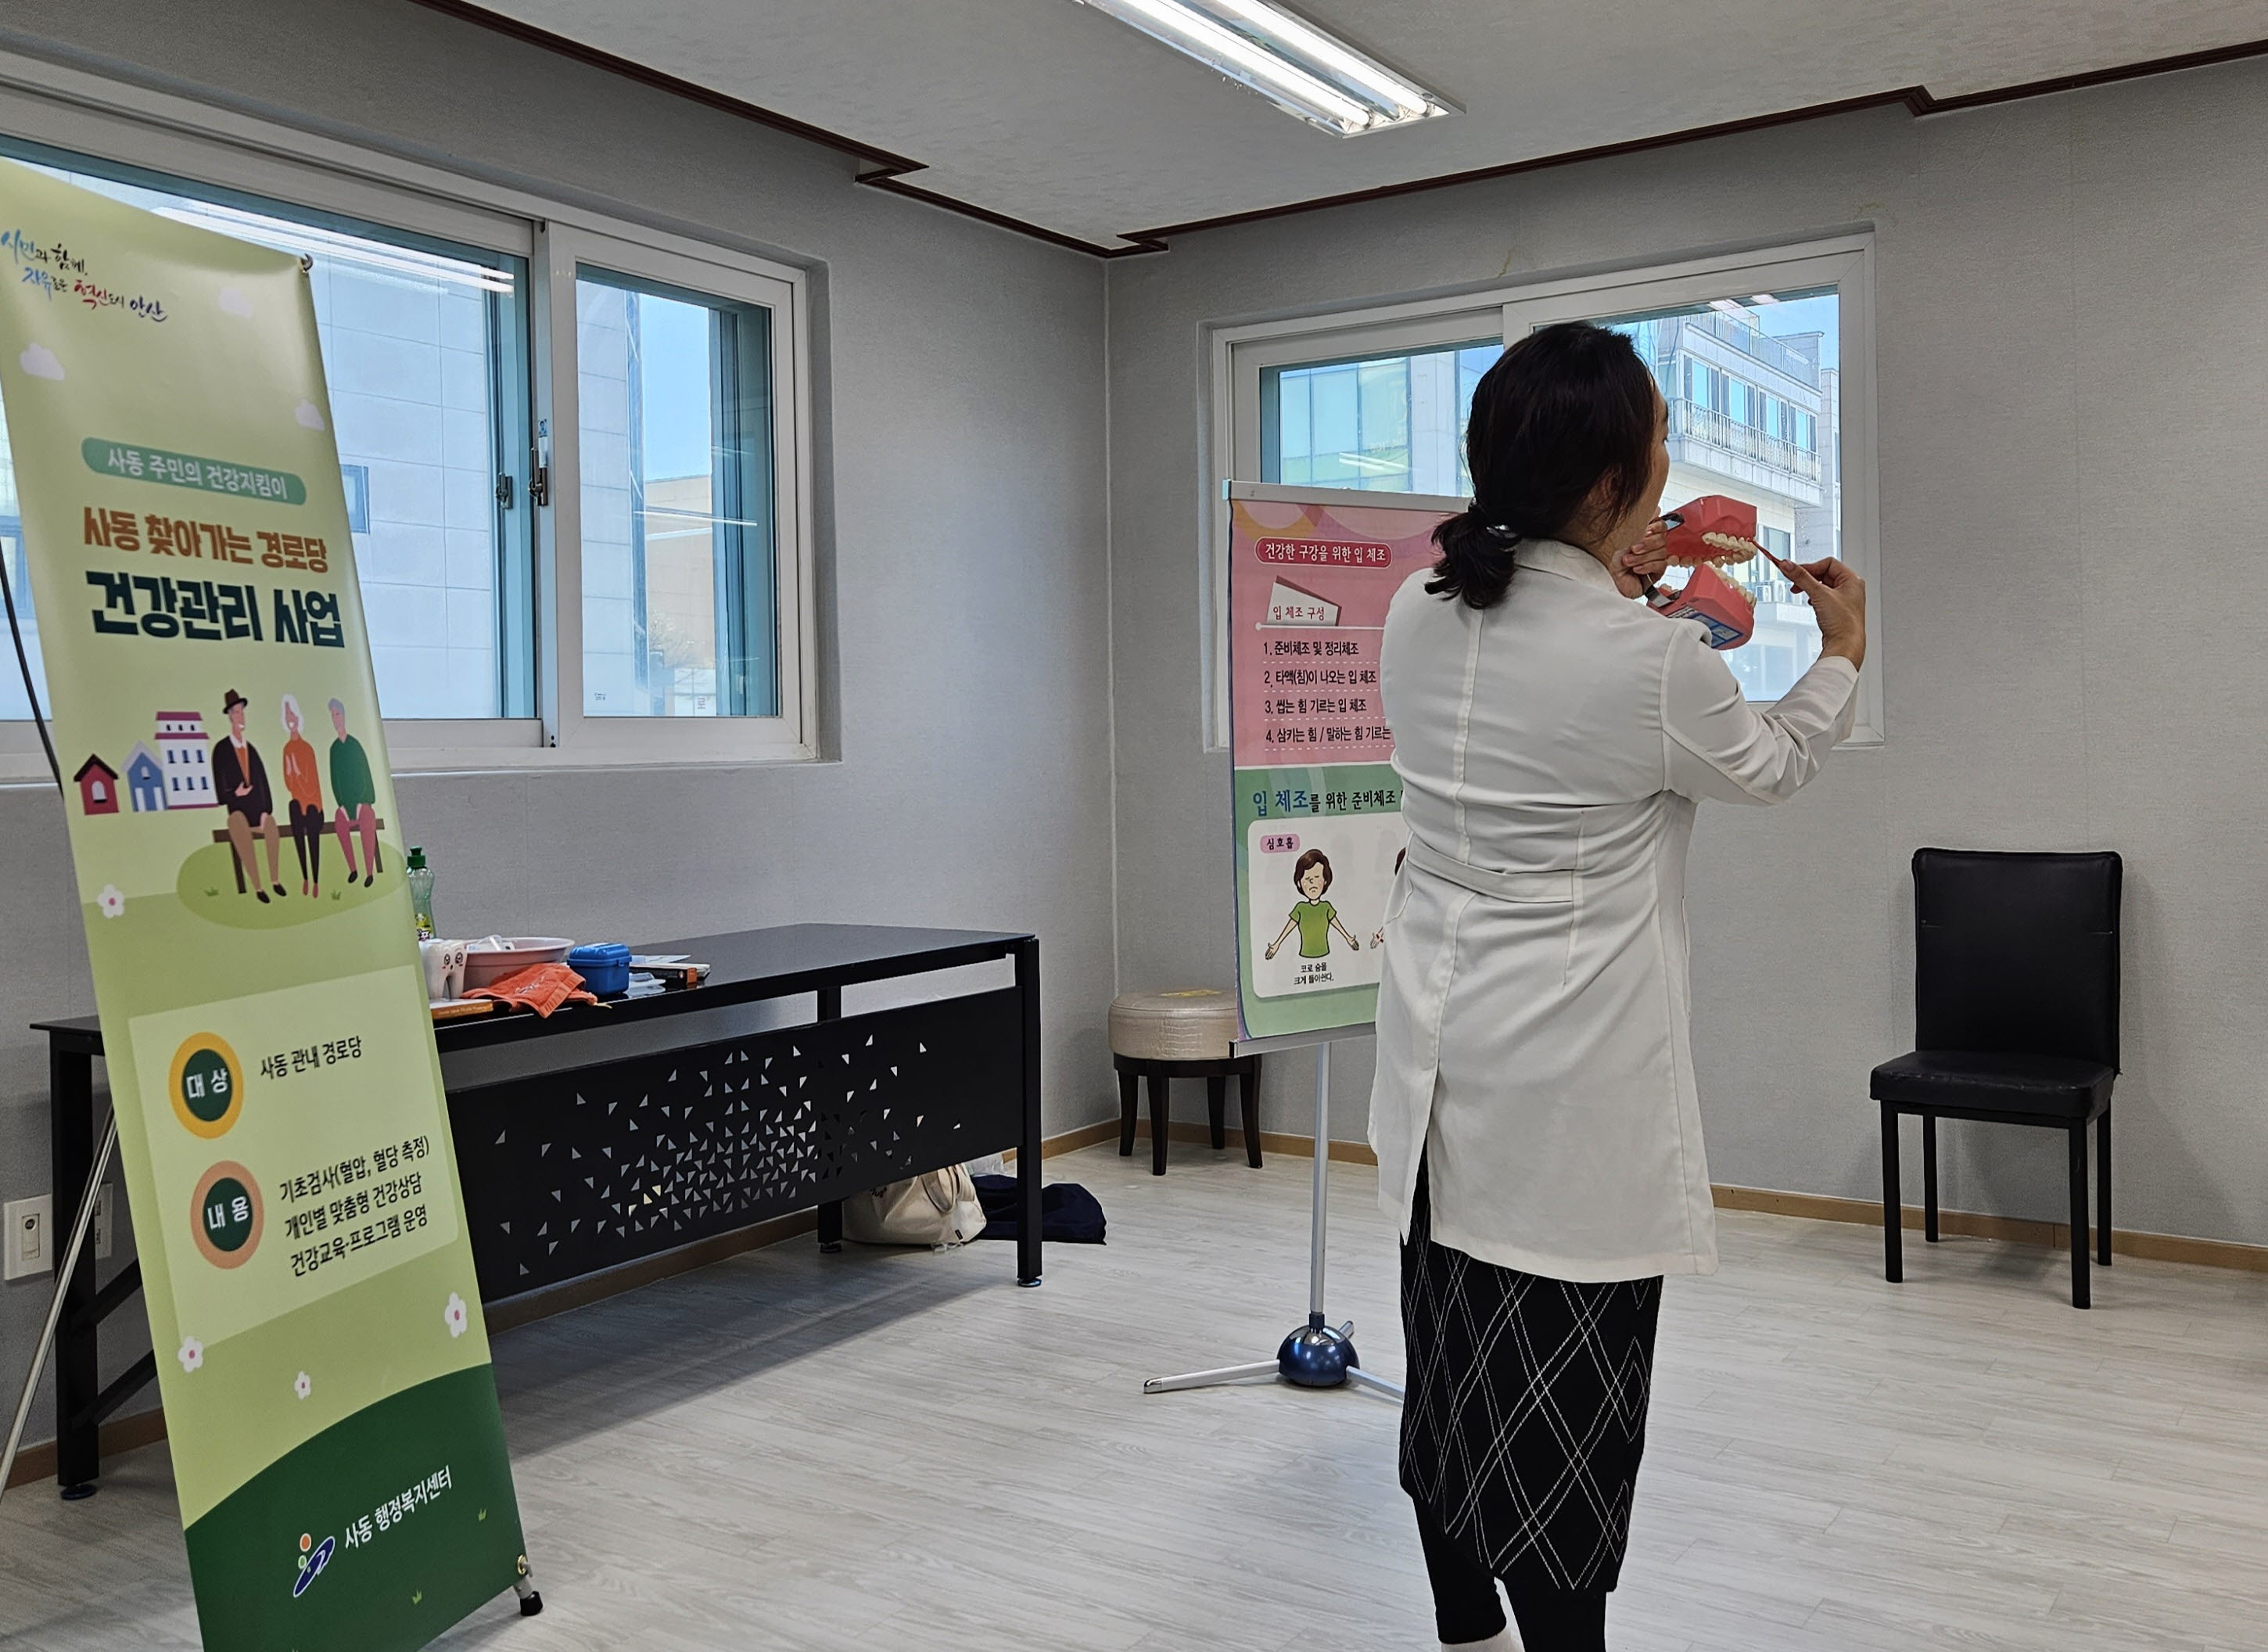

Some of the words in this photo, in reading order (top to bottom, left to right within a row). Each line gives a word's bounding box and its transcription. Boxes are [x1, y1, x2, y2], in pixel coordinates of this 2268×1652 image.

[22, 267, 68, 302] 자유로운
[130, 295, 168, 322] 안산
[107, 447, 144, 476] 사동
[149, 455, 202, 484] 주민의
[206, 465, 288, 500] 건강지킴이
[84, 506, 141, 552] 사동
[145, 514, 253, 564] 찾아가는
[257, 530, 328, 573] 경로당
[1265, 543, 1295, 561] 건강한
[1299, 545, 1327, 562] 구강을
[1332, 546, 1351, 563] 위한
[1355, 547, 1363, 563] 입
[1366, 547, 1387, 562] 체조
[85, 570, 264, 641] 건강관리
[274, 588, 345, 648] 사업
[1272, 605, 1282, 620] 입
[1285, 605, 1303, 619] 체조
[1307, 607, 1325, 621] 구성
[1264, 642, 1272, 656] 1.
[1274, 641, 1310, 656] 준비체조
[1313, 641, 1322, 656] 및
[1324, 641, 1359, 656] 정리체조
[1264, 670, 1273, 688] 2.
[1276, 670, 1318, 685] 타액(침)이
[1320, 670, 1346, 684] 나오는
[1348, 670, 1357, 684] 입
[1359, 670, 1376, 684] 체조
[1265, 700, 1274, 714] 3.
[1276, 699, 1294, 713] 씹는
[1297, 699, 1307, 713] 힘
[1310, 698, 1335, 713] 기르는
[1338, 698, 1347, 713] 입
[1350, 698, 1366, 712] 체조
[1265, 729, 1274, 743] 4.
[1277, 727, 1304, 743] 삼키는
[1308, 727, 1317, 742] 힘
[1319, 727, 1324, 742] /
[1326, 726, 1351, 742] 말하는
[1355, 726, 1363, 740] 힘
[1365, 726, 1391, 741] 기르는
[1253, 790, 1267, 817] 입
[1275, 789, 1321, 813] 체조를
[1326, 792, 1347, 811] 위한
[1351, 790, 1396, 810] 준비체조
[1294, 975, 1307, 985] 크게
[1301, 964, 1313, 973] 코로
[260, 1054, 288, 1079] 사동
[291, 1045, 321, 1072] 관내
[322, 1035, 362, 1064] 경로당
[279, 1155, 371, 1203] 기초검사(혈압,
[373, 1145, 398, 1173] 혈당
[402, 1135, 430, 1162] 측정)
[285, 1205, 328, 1240] 개인별
[330, 1190, 370, 1226] 맞춤형
[372, 1171, 422, 1208] 건강상담
[404, 1203, 428, 1233] 운영
[345, 1514, 373, 1549] 사동
[375, 1464, 453, 1532] 행정복지센터
